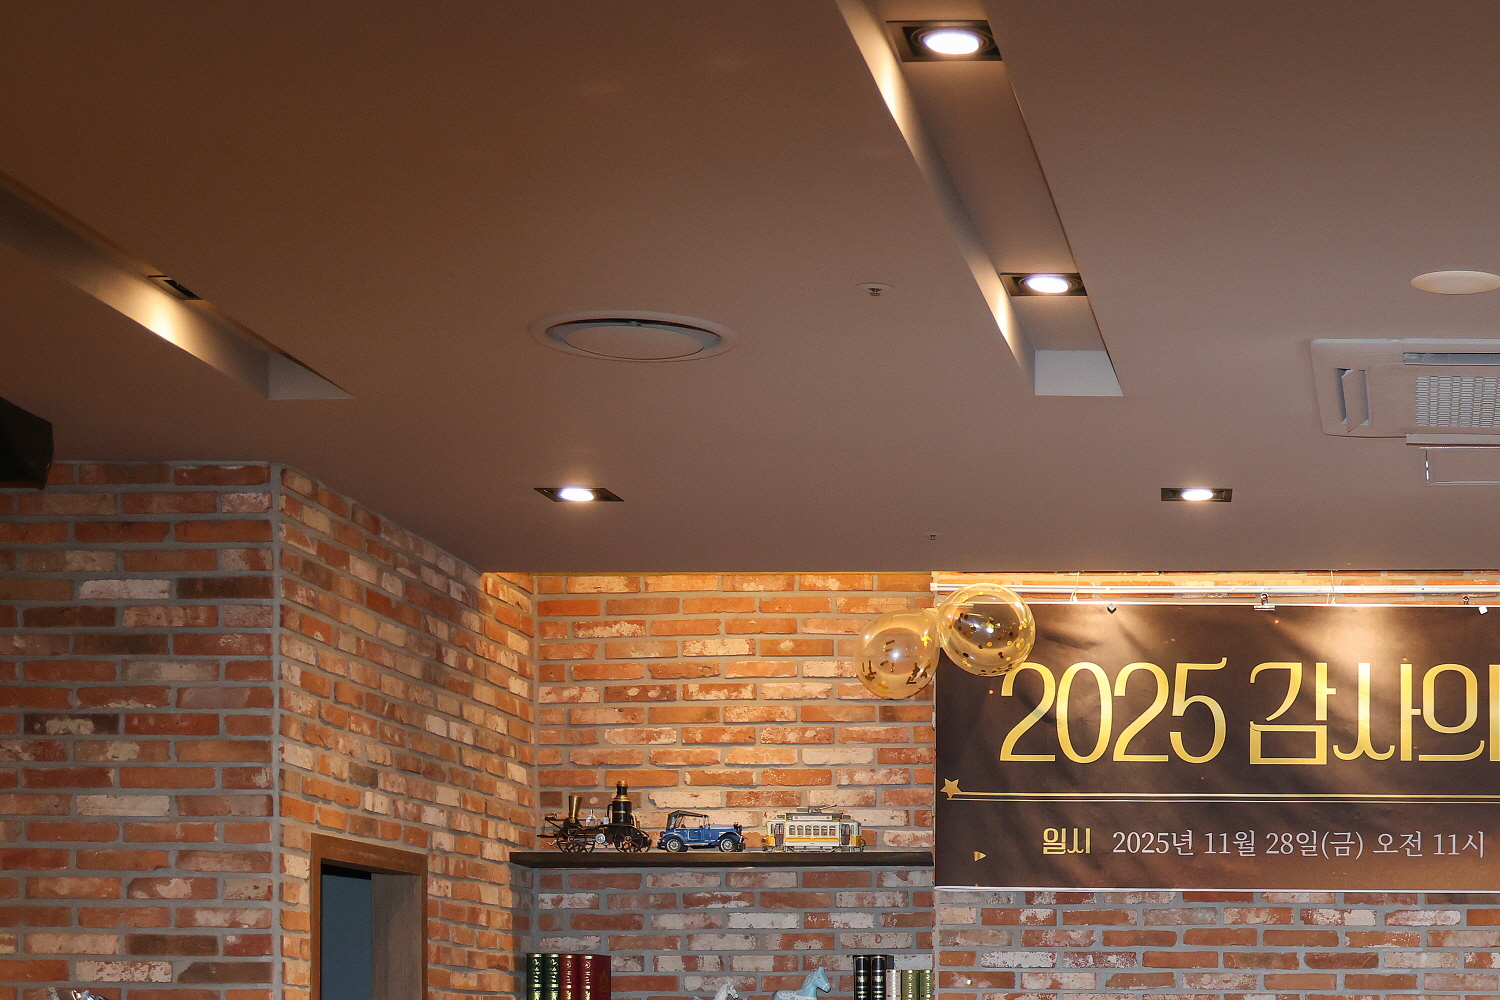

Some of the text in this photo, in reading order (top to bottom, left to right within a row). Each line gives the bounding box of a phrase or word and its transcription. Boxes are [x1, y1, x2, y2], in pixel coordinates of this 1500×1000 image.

[999, 657, 1227, 763] 2025
[1042, 828, 1486, 860] 일시 2025년 11월 28일(금) 오전 11시
